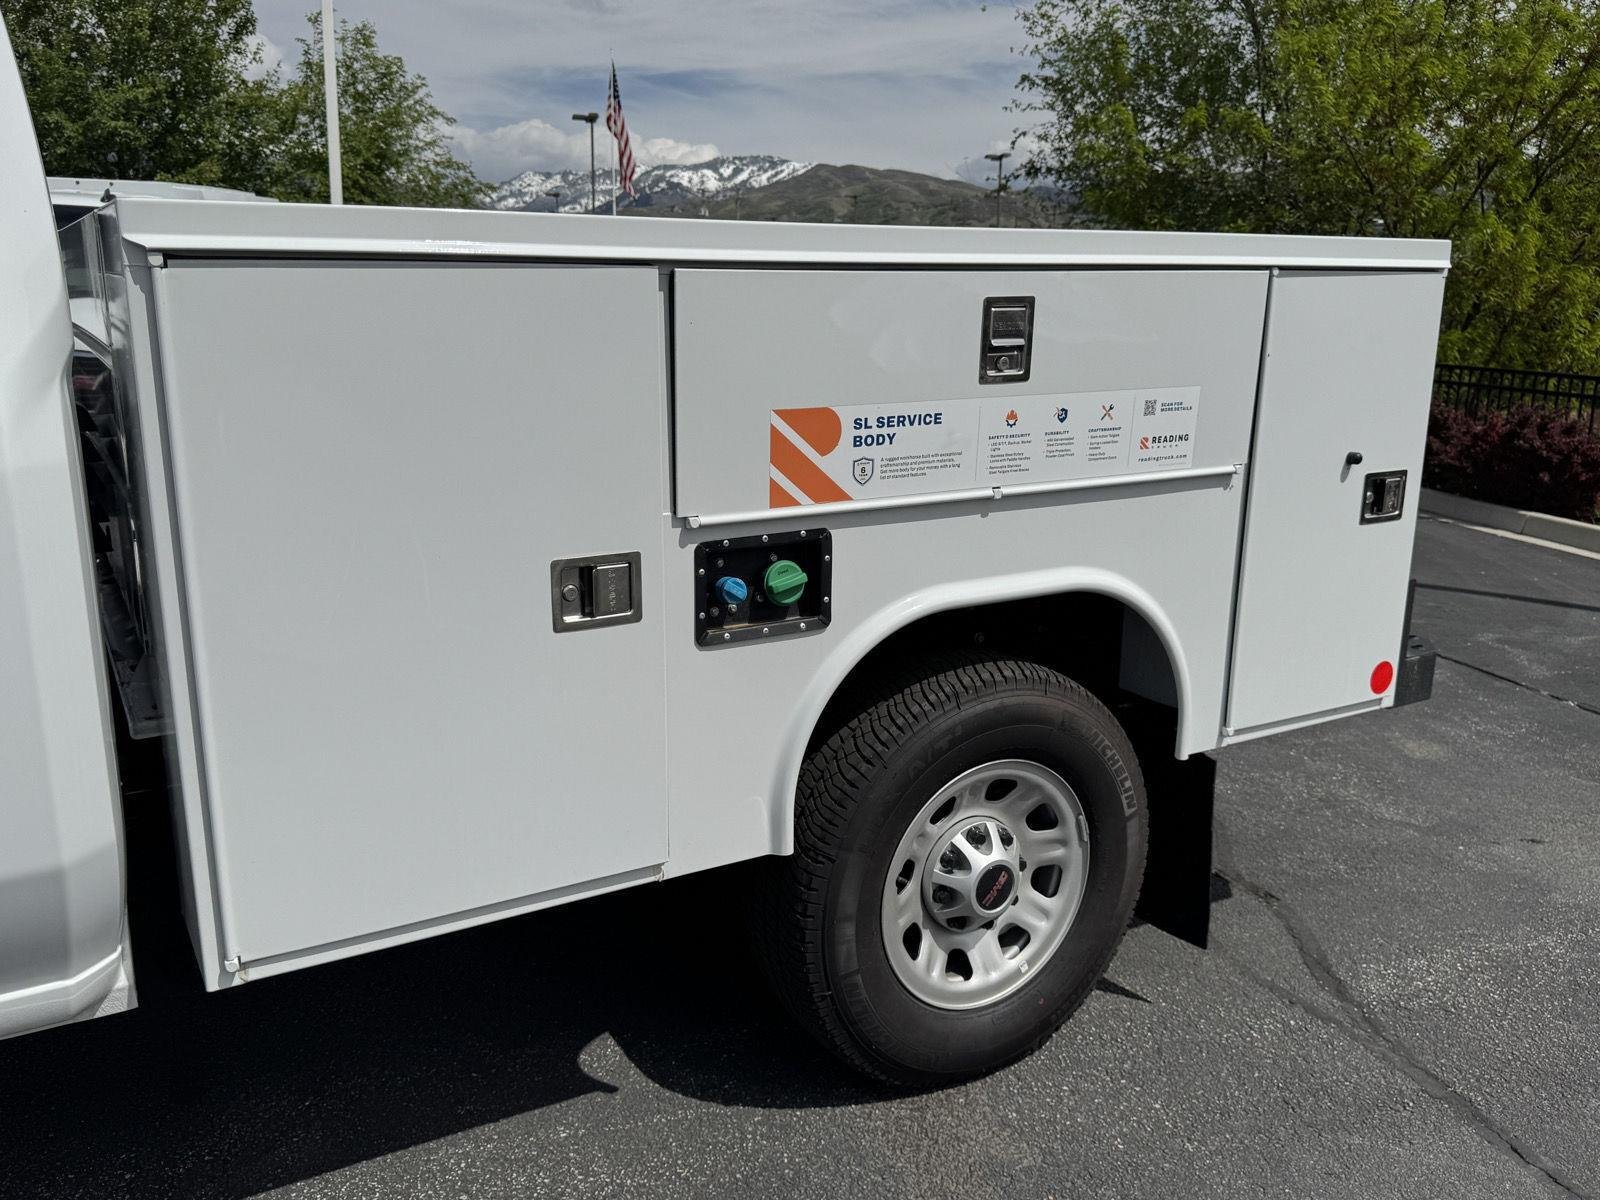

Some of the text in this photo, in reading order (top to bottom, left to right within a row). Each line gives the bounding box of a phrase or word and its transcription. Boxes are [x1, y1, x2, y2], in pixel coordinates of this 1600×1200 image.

[853, 412, 942, 430] SL SERVICE
[852, 433, 896, 448] BODY
[1152, 433, 1189, 444] READING
[885, 455, 899, 463] rugged
[1138, 454, 1187, 462] readingtruck.com
[880, 460, 909, 469] craftsmanship
[861, 466, 866, 474] 6
[900, 466, 910, 474] body
[1085, 726, 1138, 818] MICHELIN
[982, 870, 1009, 907] GMC
